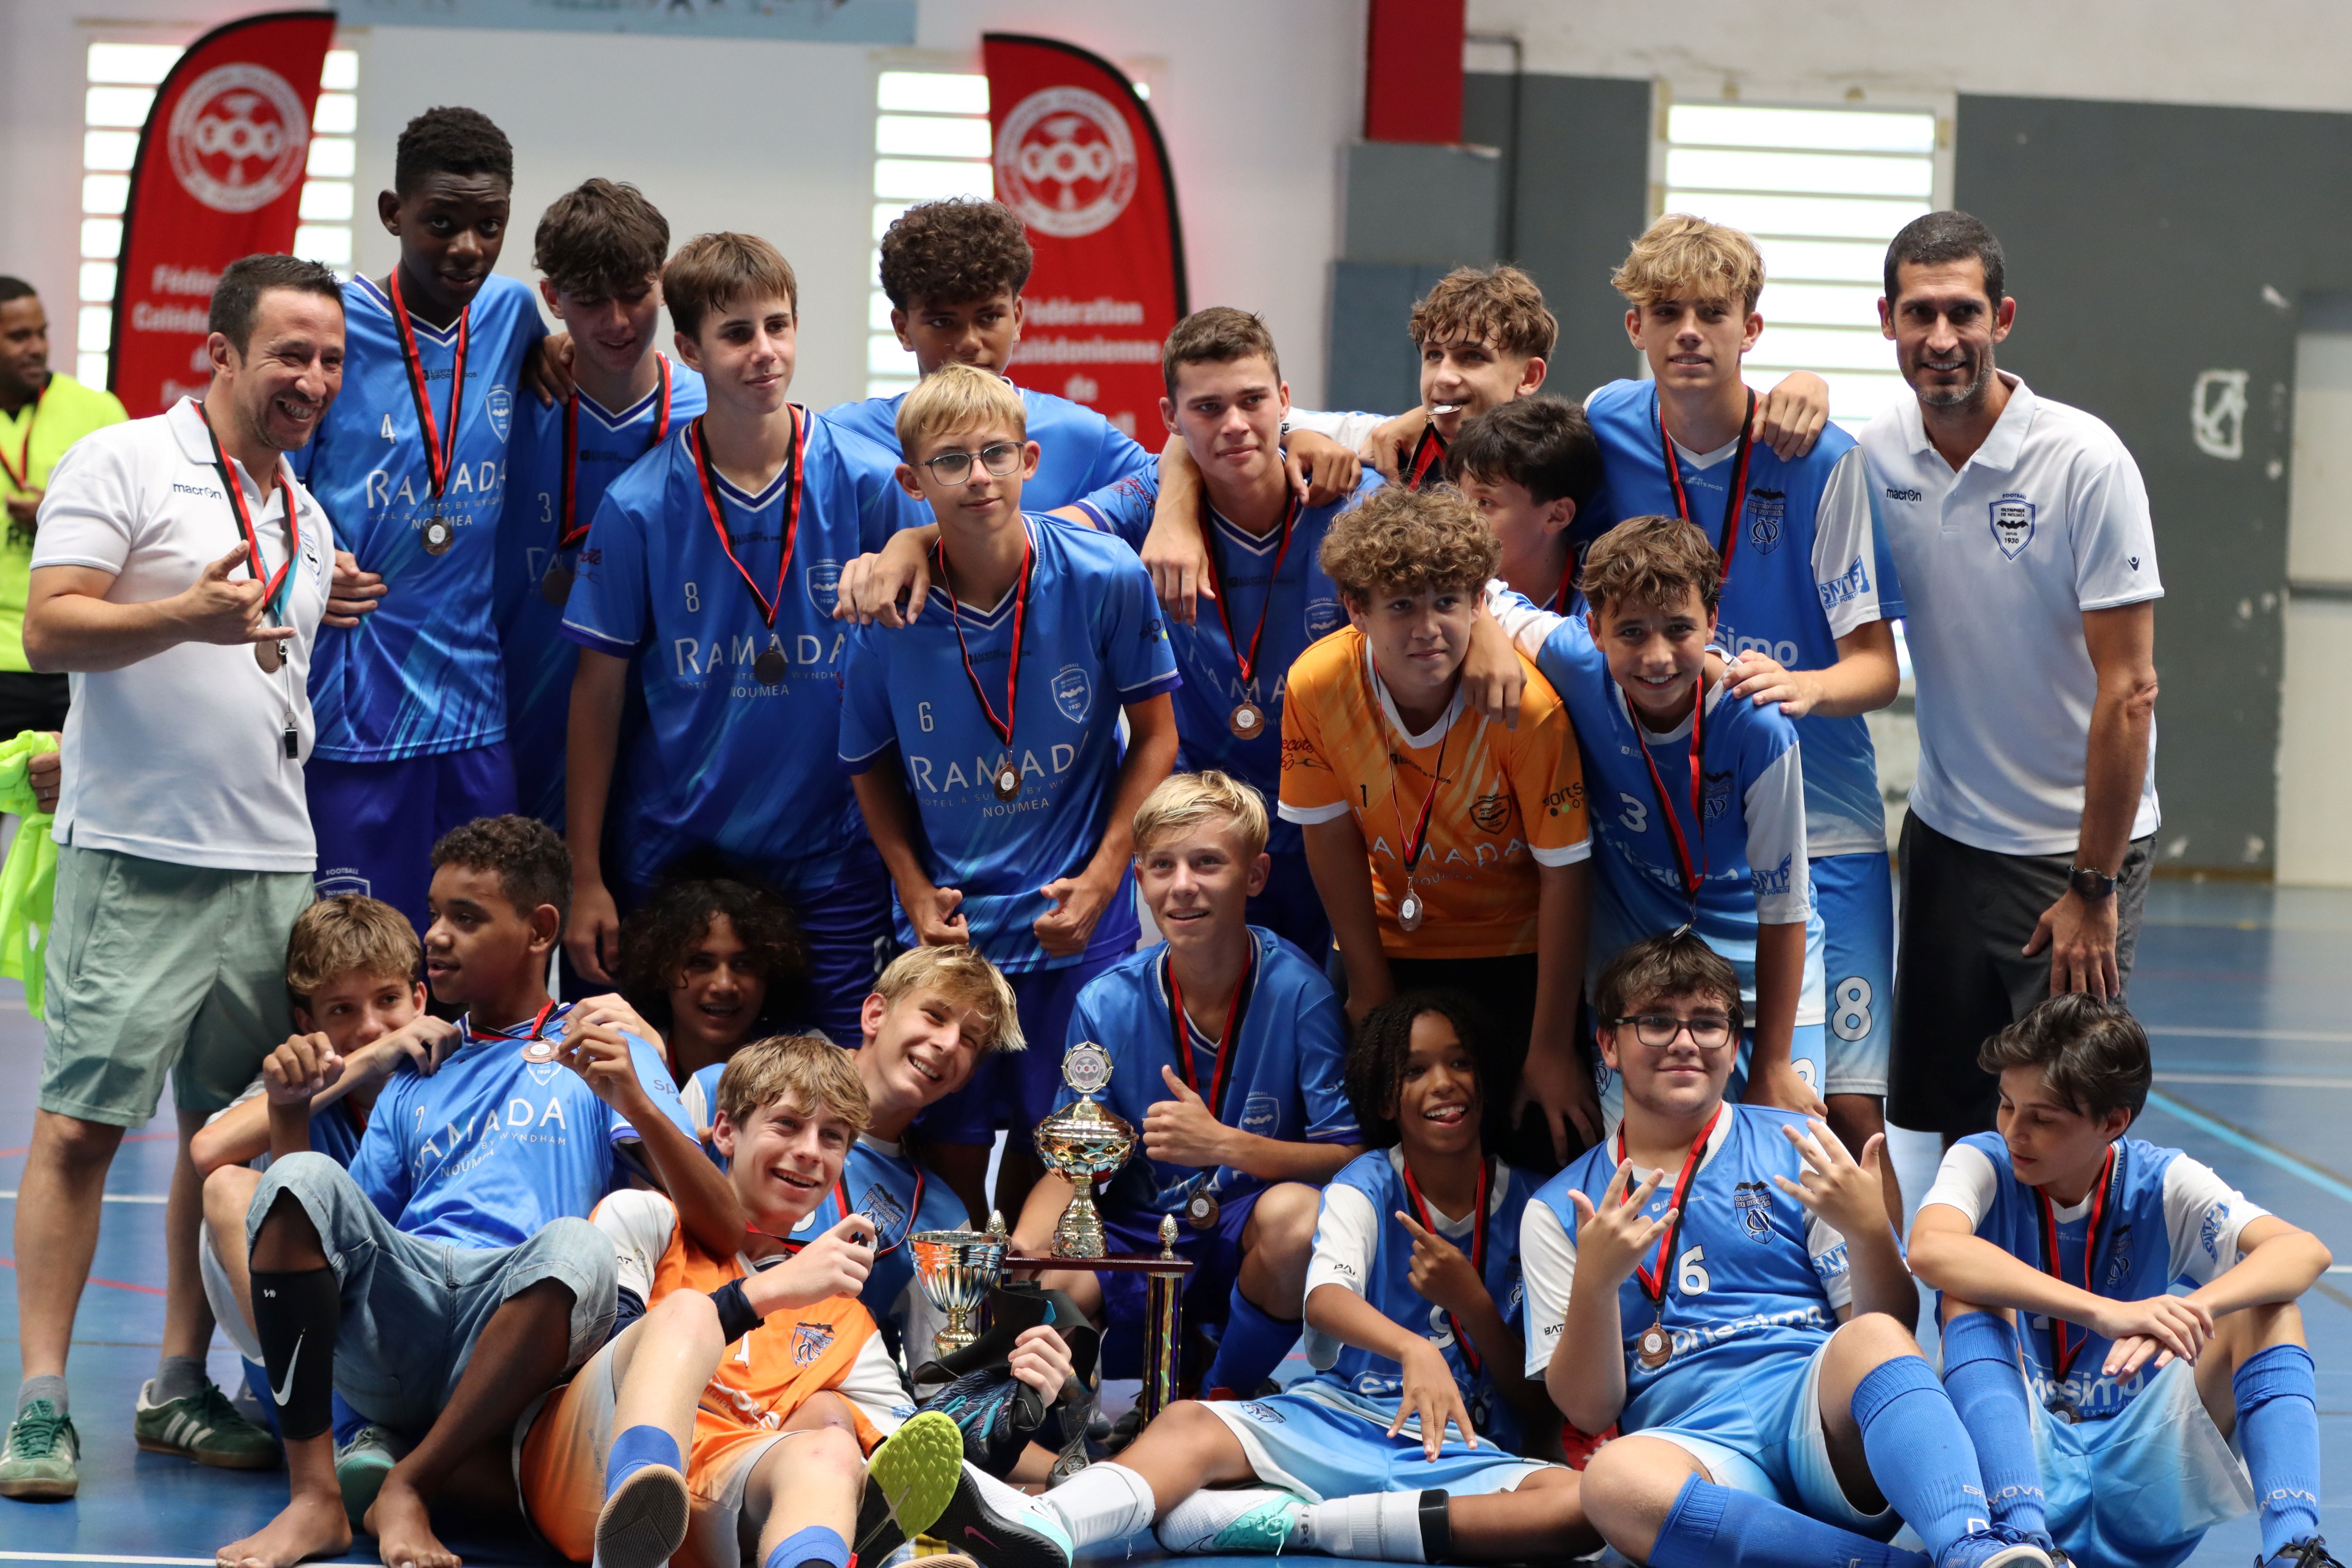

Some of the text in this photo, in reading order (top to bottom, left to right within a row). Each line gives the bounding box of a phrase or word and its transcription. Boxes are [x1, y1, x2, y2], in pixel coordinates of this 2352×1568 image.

[1065, 373, 1098, 403] de
[381, 413, 396, 445] 4
[173, 483, 222, 500] macron
[367, 458, 506, 508] RAADA
[1708, 483, 1723, 491] PROS
[1886, 488, 1922, 502] macron
[538, 492, 552, 523] 3
[411, 514, 473, 530] NOMEA
[684, 582, 700, 613] 8
[1059, 663, 1080, 673] FOOTBALL
[1060, 675, 1081, 686] OLYMPIQUE
[730, 685, 789, 698] NOUMEA
[1068, 702, 1081, 711] 1930
[918, 701, 934, 732] 6
[910, 730, 1089, 794] RAMAD
[1027, 786, 1042, 795] BY
[1359, 784, 1368, 808] 1
[982, 798, 1050, 818] NOUMEA
[1617, 792, 1648, 833] 3
[326, 868, 359, 877] FOOTBALL
[1831, 976, 1873, 1042] 8
[499, 1133, 567, 1146] WYNDHAM
[1687, 1195, 1705, 1203] PROS
[1678, 1245, 1710, 1296] 6
